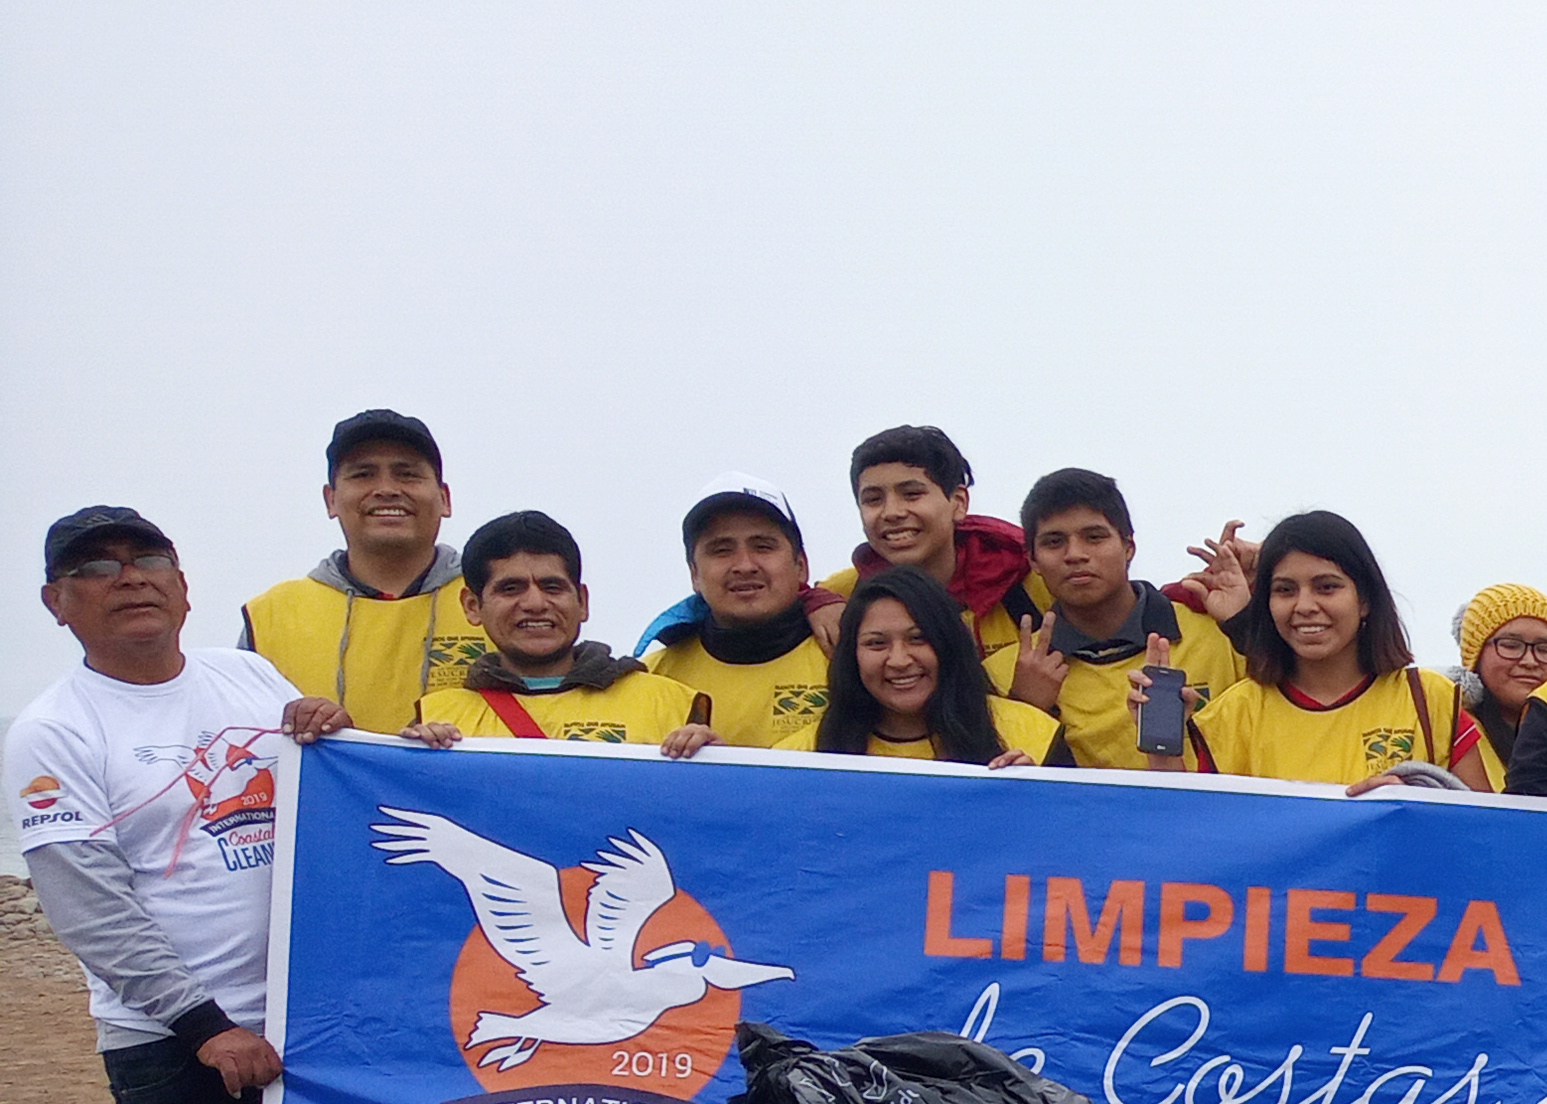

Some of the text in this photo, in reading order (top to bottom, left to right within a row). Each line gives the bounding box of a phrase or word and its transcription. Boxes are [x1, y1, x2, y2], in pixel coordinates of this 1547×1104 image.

[241, 793, 268, 806] 2019
[22, 811, 83, 829] REPSOL
[209, 811, 274, 832] INTERNATIONA
[922, 869, 1522, 987] LIMPIEZA
[611, 1050, 692, 1079] 2019
